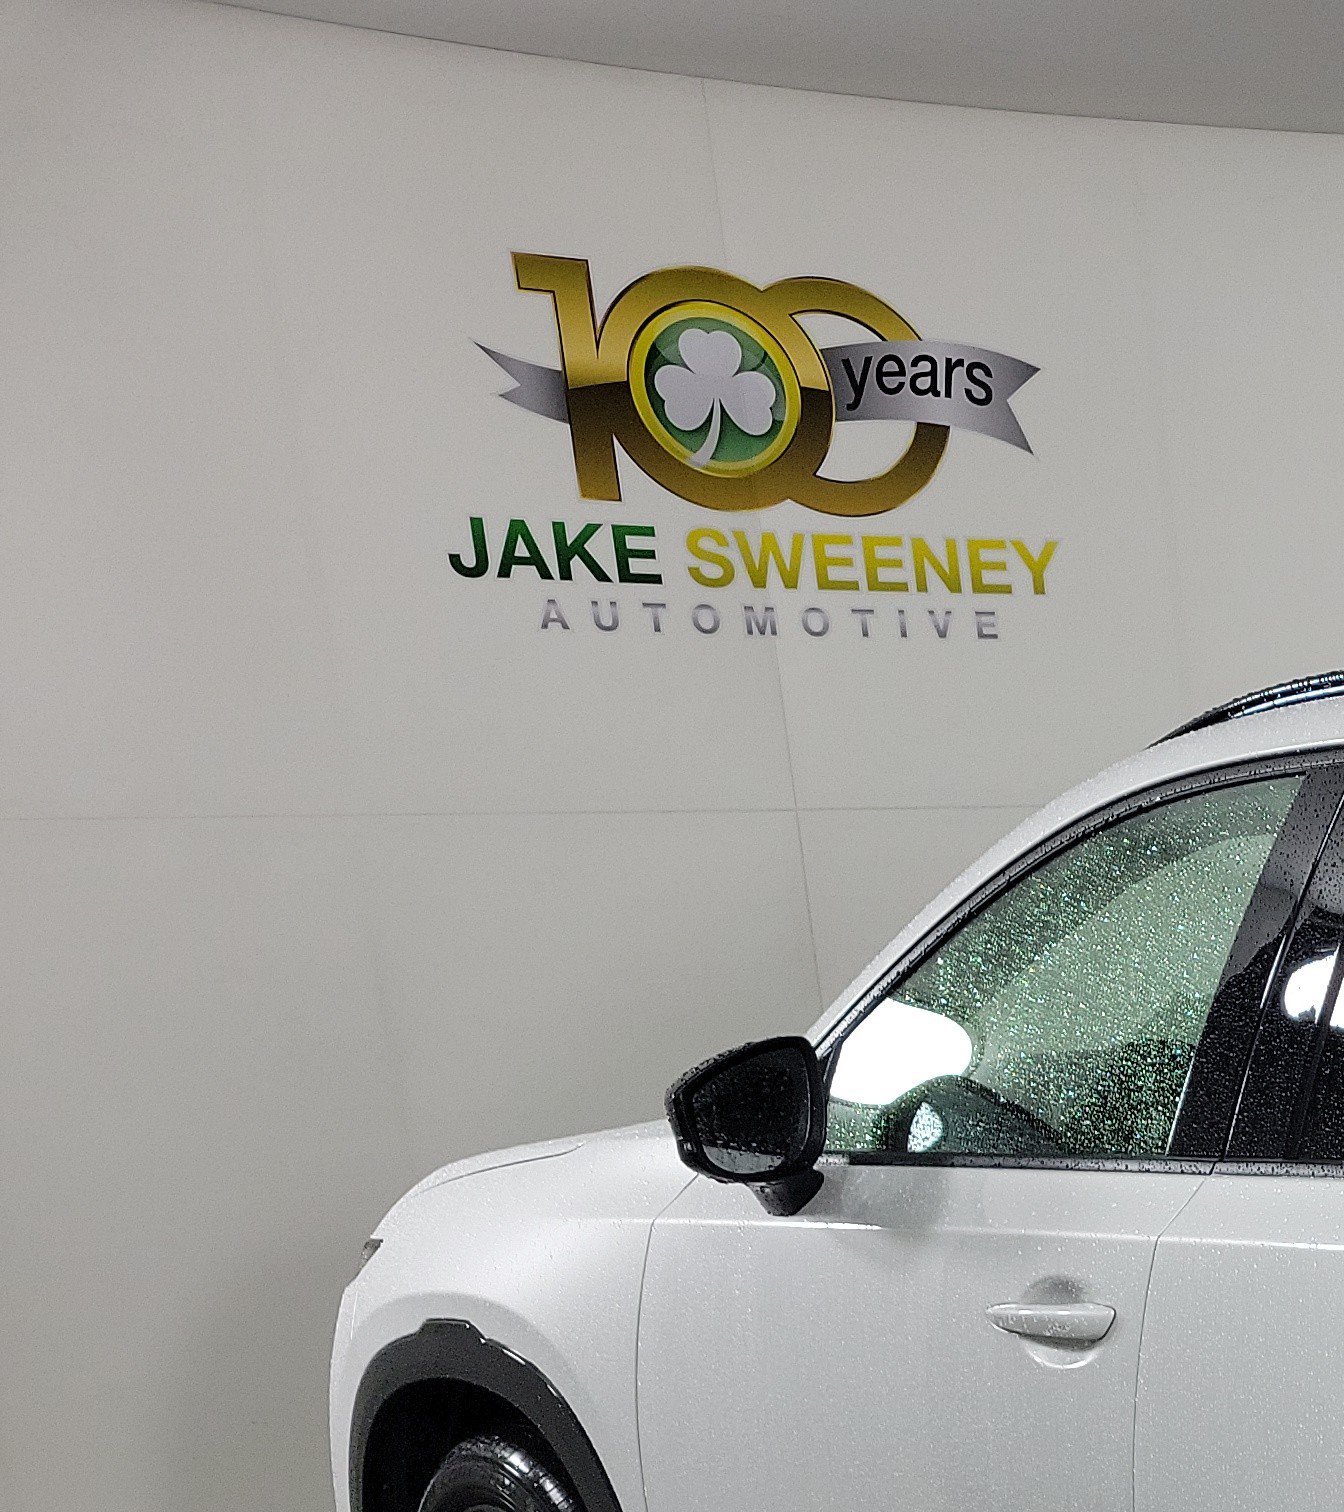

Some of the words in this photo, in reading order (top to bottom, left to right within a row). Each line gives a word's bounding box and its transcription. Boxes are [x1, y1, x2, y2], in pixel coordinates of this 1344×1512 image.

[841, 350, 994, 411] years
[448, 516, 663, 584] JAKE
[685, 528, 1059, 595] SWEENEY
[540, 599, 999, 640] AUTOMOTIVE
